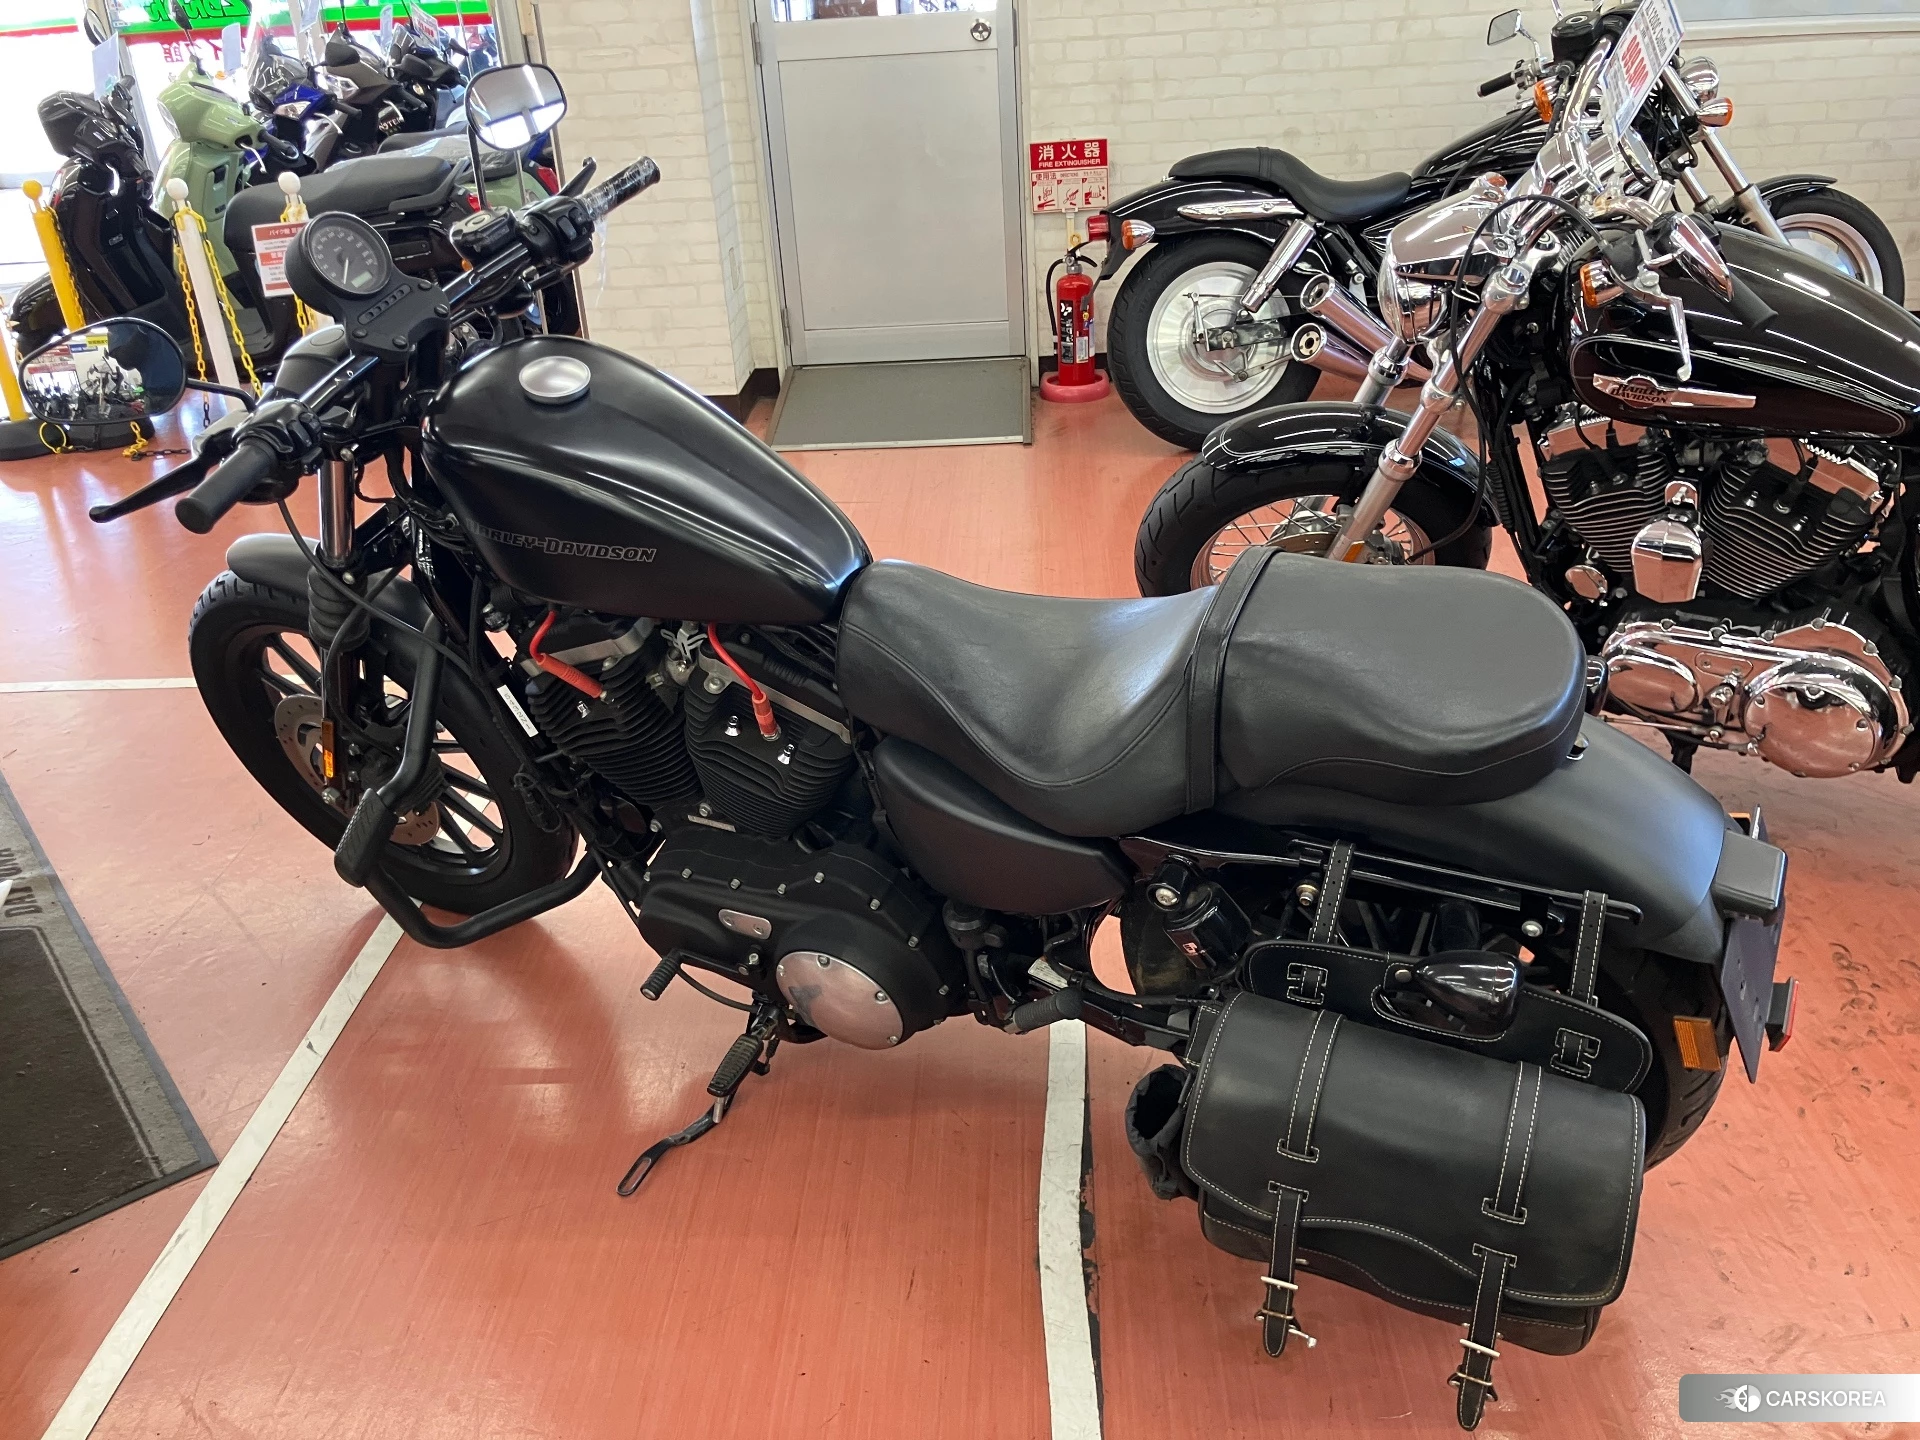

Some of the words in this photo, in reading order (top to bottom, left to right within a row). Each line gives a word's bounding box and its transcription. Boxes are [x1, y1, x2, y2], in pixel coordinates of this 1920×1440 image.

[1038, 142, 1100, 161] 消火器
[1054, 158, 1101, 168] EXTINGUISHER
